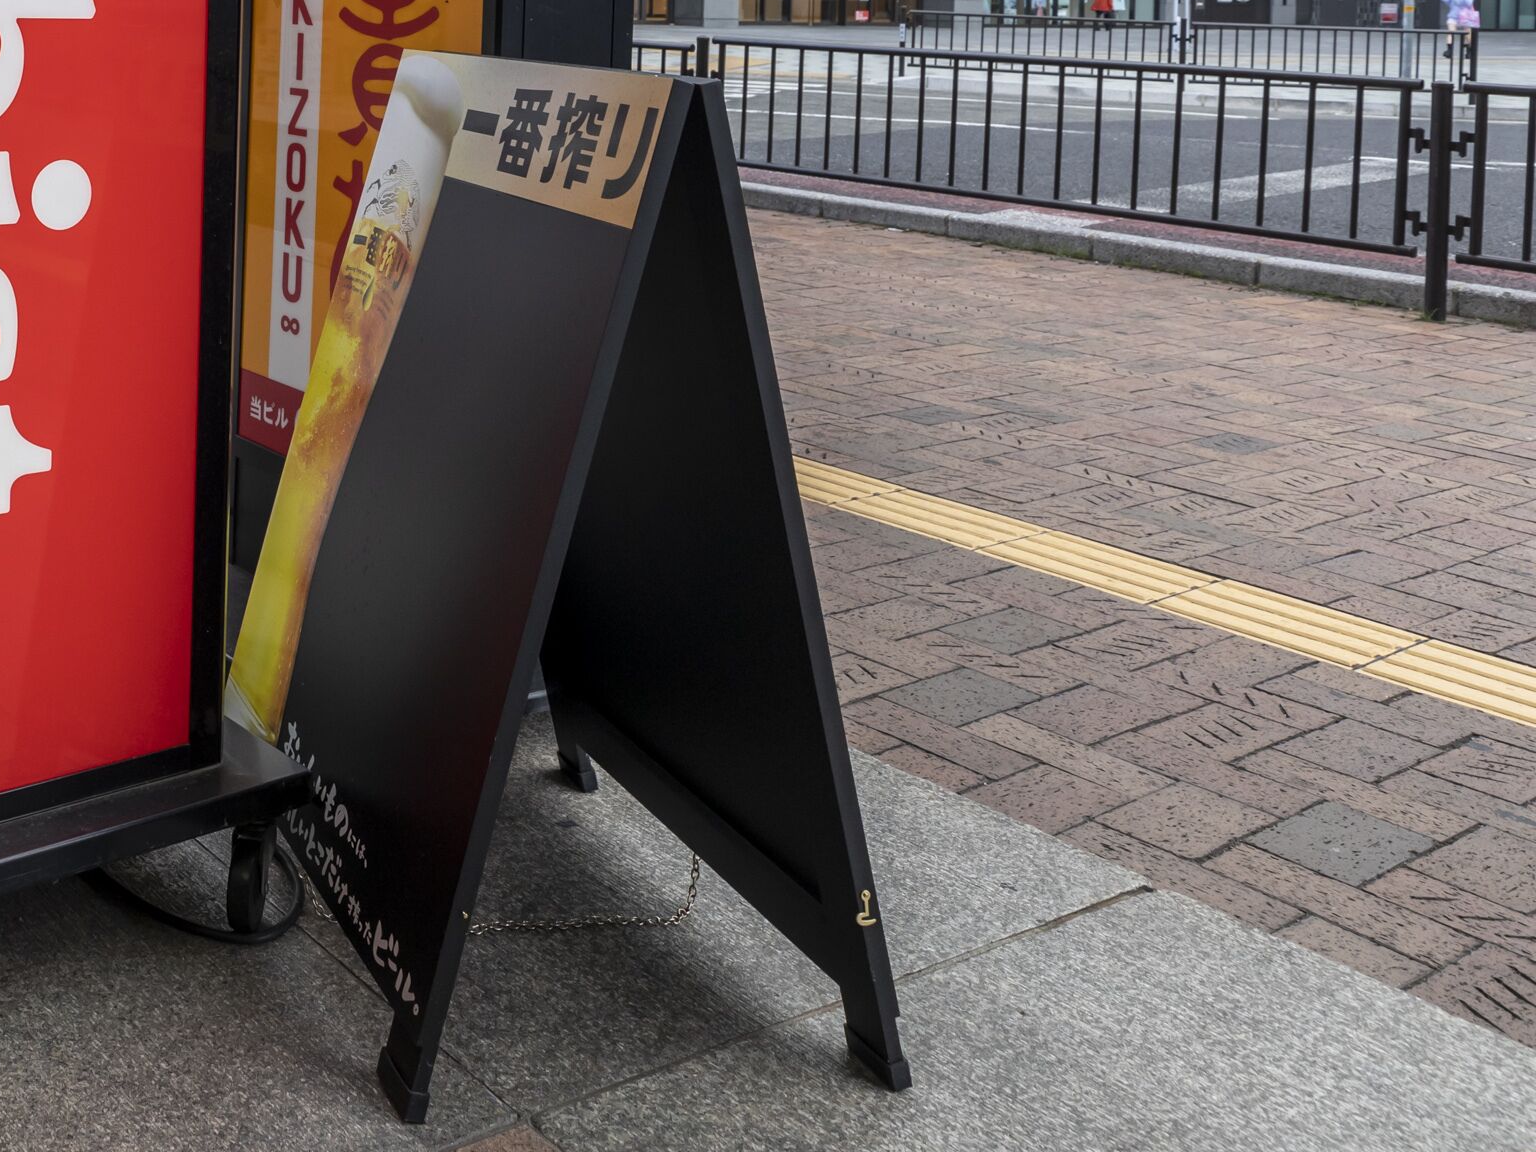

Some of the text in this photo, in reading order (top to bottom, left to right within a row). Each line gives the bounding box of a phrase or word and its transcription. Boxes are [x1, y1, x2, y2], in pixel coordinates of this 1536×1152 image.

[462, 87, 660, 201] 一番搾り
[249, 394, 289, 430] 当ビル
